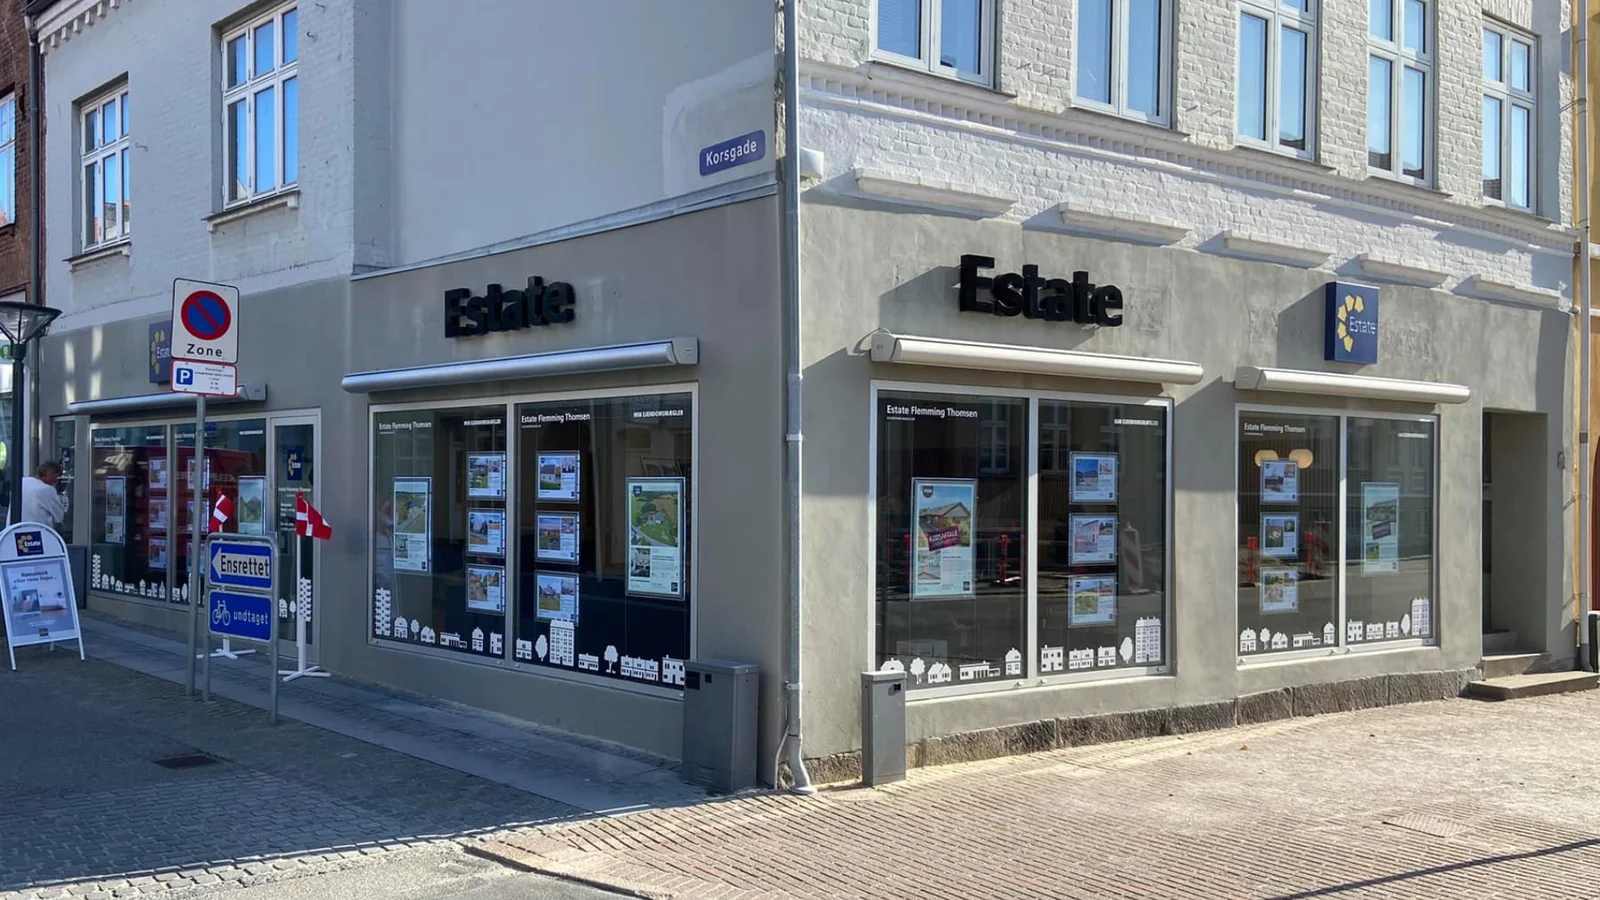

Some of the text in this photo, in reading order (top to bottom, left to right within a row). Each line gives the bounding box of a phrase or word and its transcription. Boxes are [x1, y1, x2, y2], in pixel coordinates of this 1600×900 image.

[706, 139, 757, 167] Korsgade
[959, 254, 1123, 327] Estate
[444, 275, 576, 338] Estate
[1349, 316, 1376, 335] Estate
[186, 343, 223, 358] Zone
[180, 370, 191, 383] P
[521, 412, 591, 424] Estate Flemming Thomsen
[886, 404, 909, 415] Estate
[911, 405, 945, 419] Flemming
[946, 407, 978, 418] Thomsen
[24, 540, 41, 548] Estate
[221, 555, 269, 577] Ensrettet
[233, 609, 269, 626] undtaget
